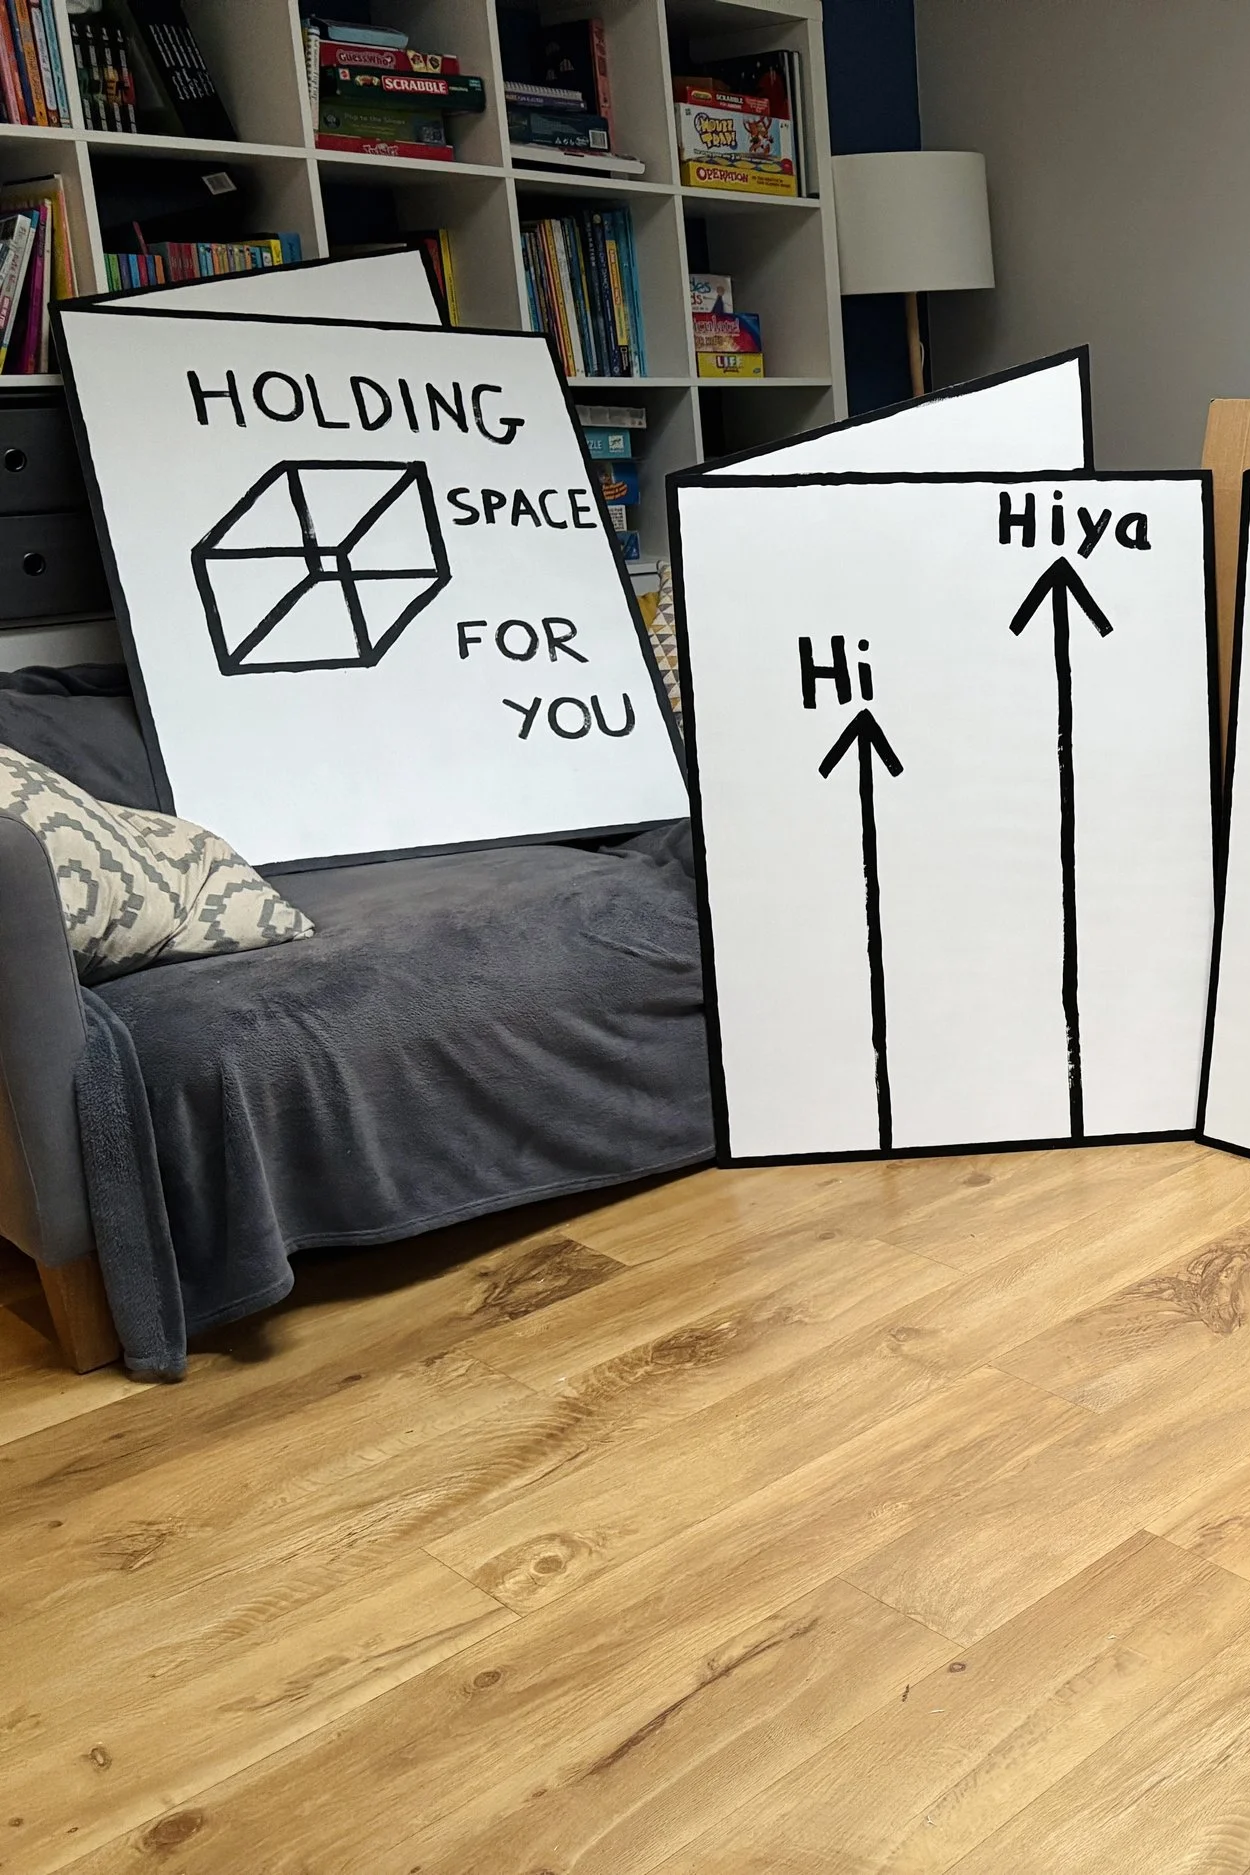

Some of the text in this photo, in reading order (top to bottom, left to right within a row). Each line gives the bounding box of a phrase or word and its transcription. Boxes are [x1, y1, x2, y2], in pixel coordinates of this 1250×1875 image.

[384, 78, 446, 94] SCRABBLE
[696, 166, 750, 184] OPERATION
[187, 370, 524, 444] HOLDING
[446, 488, 598, 529] SPACE
[999, 490, 1151, 559] Hiya
[457, 617, 589, 663] FOR
[799, 636, 874, 710] Hi
[502, 692, 636, 740] YOU
